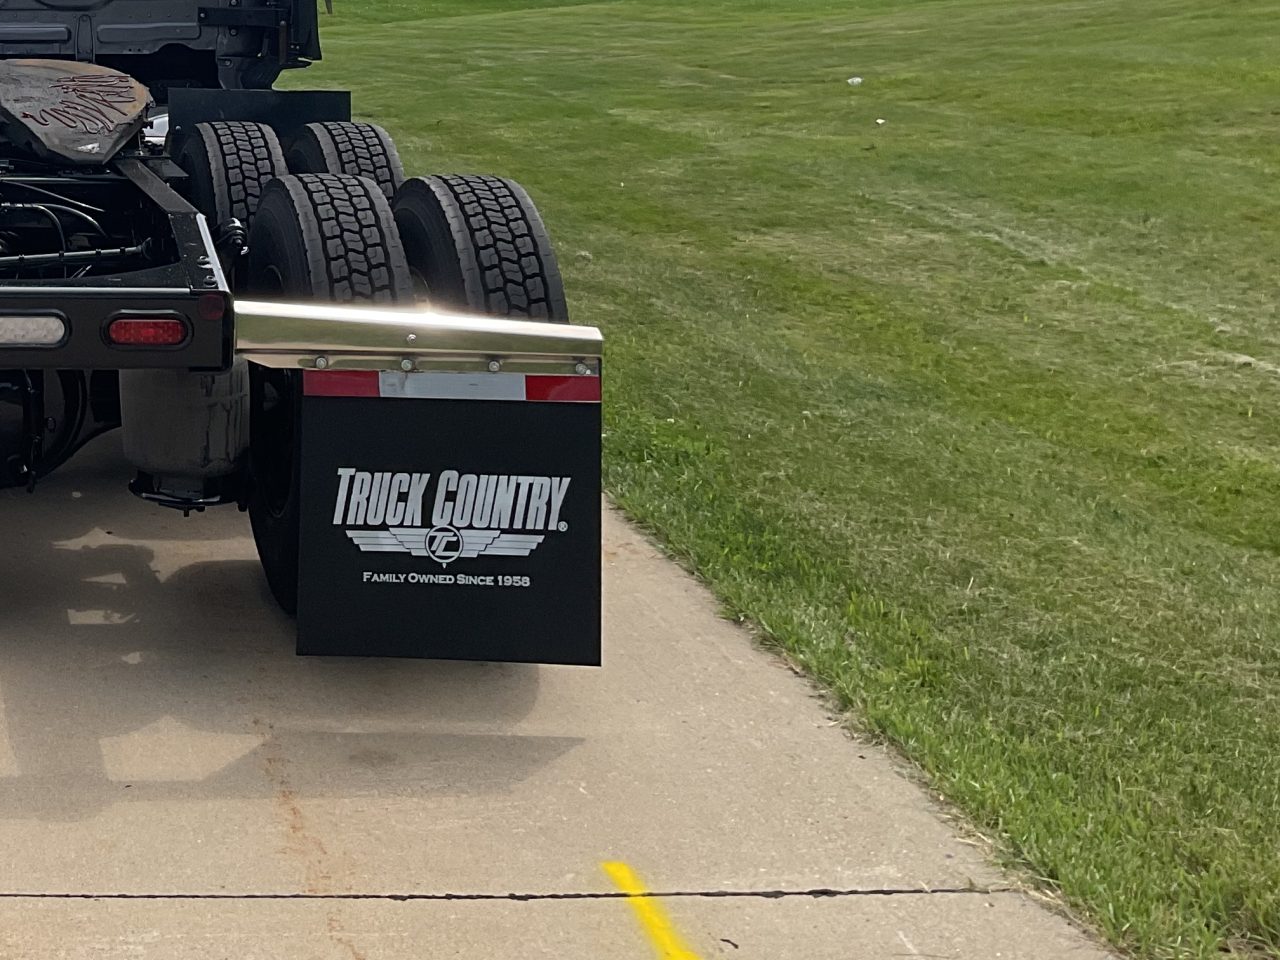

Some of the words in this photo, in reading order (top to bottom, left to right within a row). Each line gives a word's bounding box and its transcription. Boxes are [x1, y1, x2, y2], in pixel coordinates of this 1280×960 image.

[332, 467, 431, 527] TRUCK
[429, 530, 458, 557] TC
[362, 572, 407, 584] FAMILY
[408, 572, 455, 585] OWNED
[456, 573, 494, 586] SINCE
[497, 575, 531, 587] 1958
